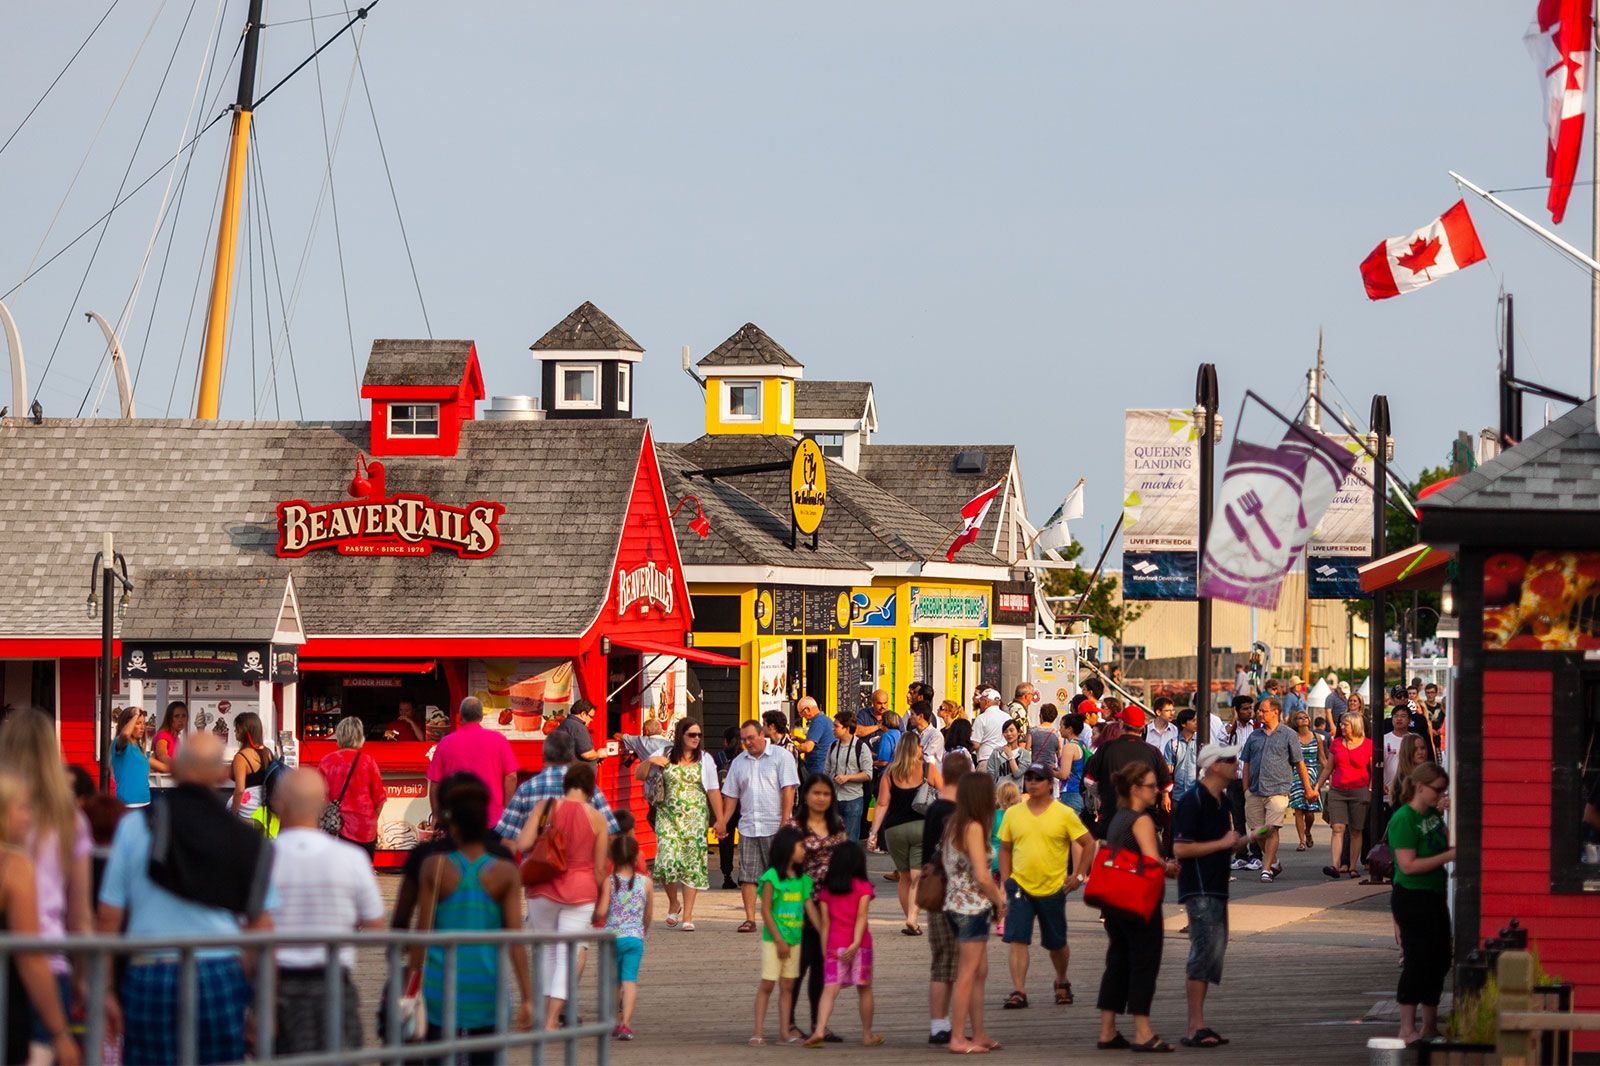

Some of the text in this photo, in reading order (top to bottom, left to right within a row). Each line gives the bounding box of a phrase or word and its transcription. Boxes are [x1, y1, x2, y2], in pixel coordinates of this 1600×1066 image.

[1134, 446, 1192, 459] QUEEN'S
[1134, 459, 1192, 469] LANDING
[1140, 477, 1185, 490] market
[1331, 492, 1361, 504] arket
[345, 545, 374, 553] PASTRY
[919, 596, 942, 616] HARBOUR
[964, 597, 980, 617] TOURS
[352, 679, 393, 687] ORDER HERE
[387, 784, 423, 796] my tail?
